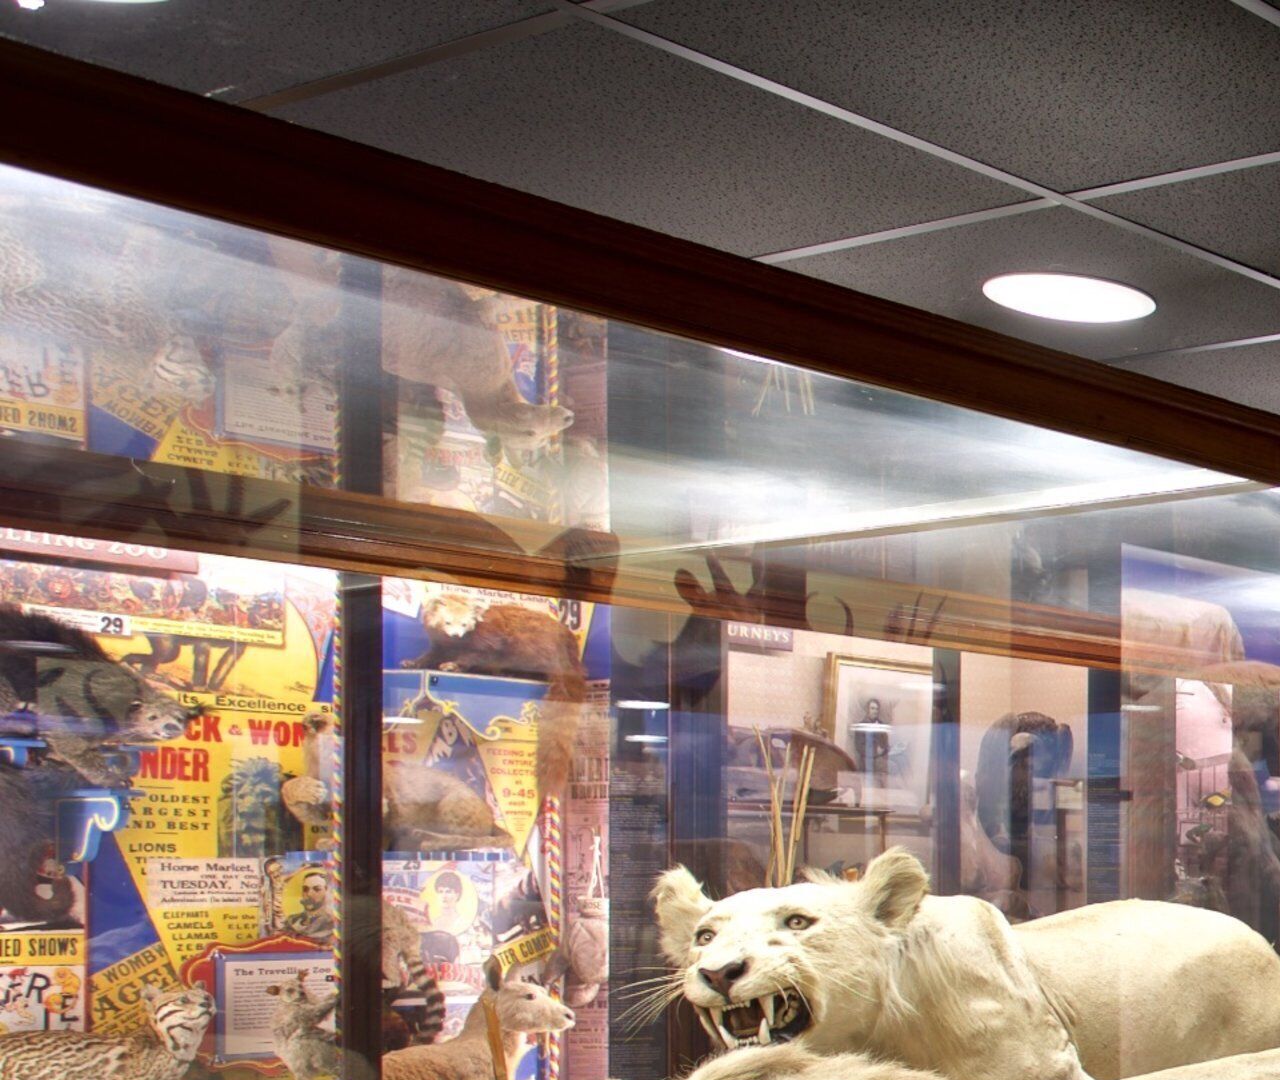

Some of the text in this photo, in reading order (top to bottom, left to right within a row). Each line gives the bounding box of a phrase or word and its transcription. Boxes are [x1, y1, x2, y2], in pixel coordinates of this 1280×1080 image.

[108, 541, 168, 560] ZOO
[100, 616, 123, 634] 29
[215, 695, 306, 712] Excellence
[228, 723, 243, 736] &
[502, 788, 536, 799] 9-45
[149, 795, 211, 805] OLDEST
[166, 820, 211, 832] BEST
[129, 843, 177, 854] LIONS
[160, 862, 254, 873] Horse Market,
[160, 880, 232, 890] TUESDAY,
[163, 910, 209, 920] ELEPHANTS
[167, 921, 214, 930] CAMELS
[172, 932, 218, 941] LLAMAS
[28, 936, 78, 957] SHOWS
[233, 968, 254, 976] The
[312, 966, 331, 975] Zoo
